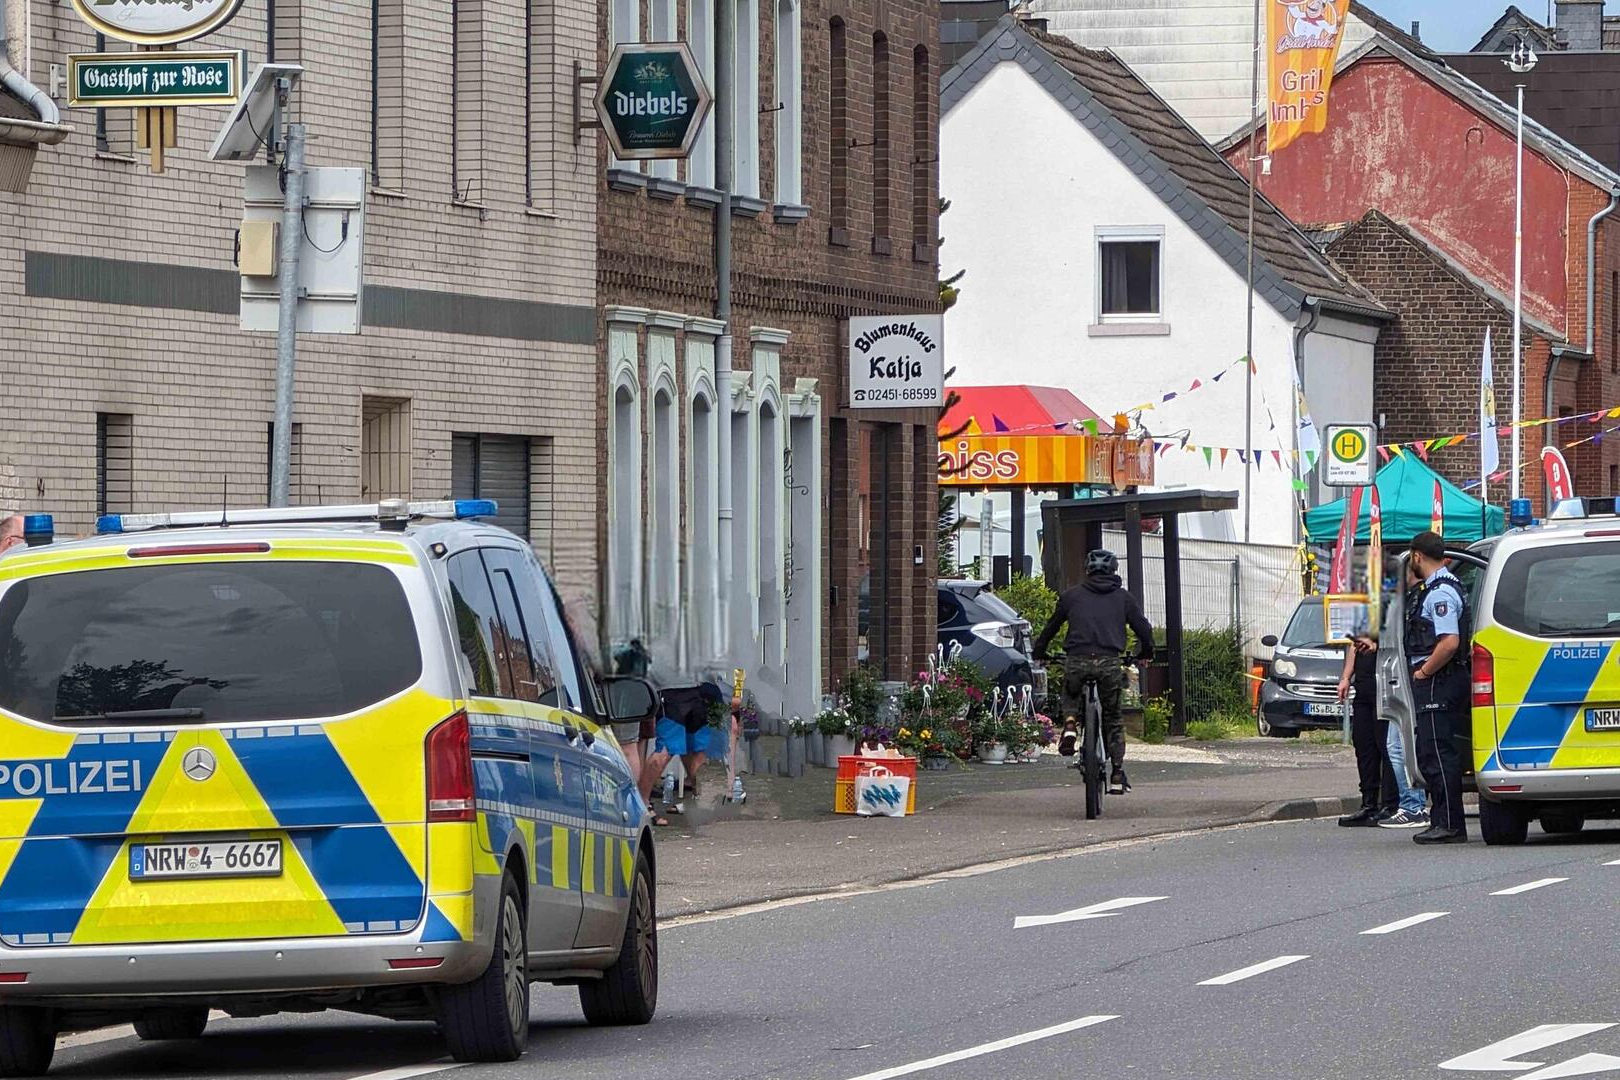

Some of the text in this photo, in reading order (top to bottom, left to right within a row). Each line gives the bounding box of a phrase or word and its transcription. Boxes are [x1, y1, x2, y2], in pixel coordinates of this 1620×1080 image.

[84, 65, 223, 93] Gasthof zur Rose
[854, 321, 936, 354] Blumenhaus
[869, 355, 923, 382] Katja
[868, 388, 937, 401] 02451-68599
[1553, 648, 1600, 660] POLIZEI
[145, 847, 187, 871] NRW
[200, 843, 279, 869] 4-6667
